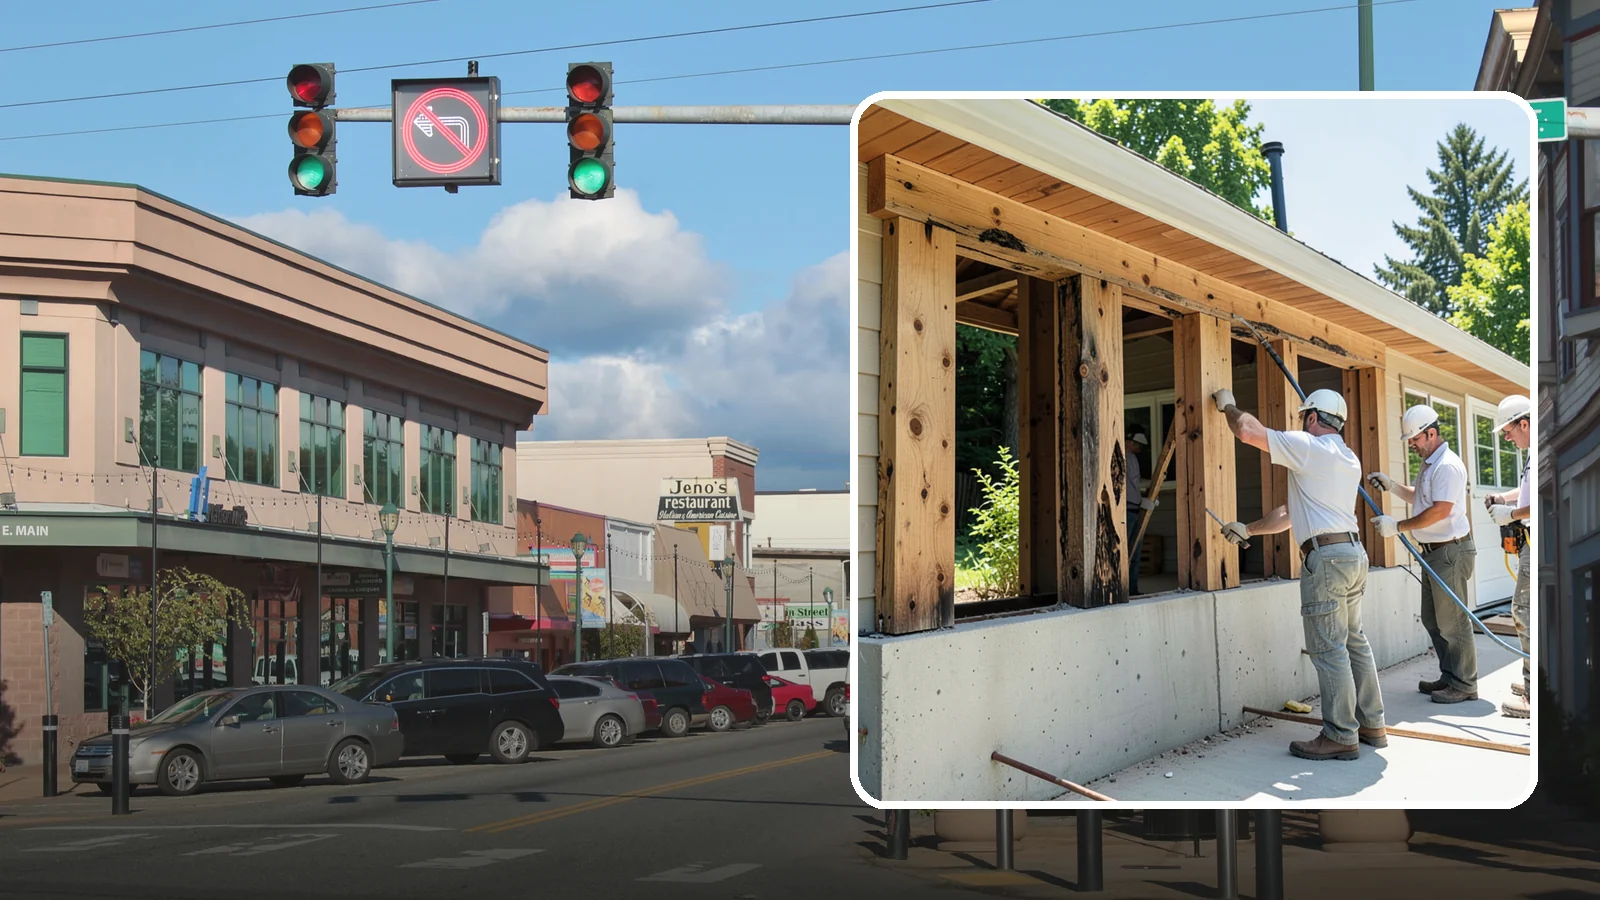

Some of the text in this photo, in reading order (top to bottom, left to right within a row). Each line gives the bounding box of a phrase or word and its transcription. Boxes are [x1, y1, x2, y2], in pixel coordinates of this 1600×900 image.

[670, 480, 728, 494] Jeno's
[665, 496, 731, 509] restaurant
[658, 510, 682, 520] Italian
[686, 510, 714, 519] American
[714, 510, 737, 519] Cuisine
[2, 525, 49, 536] E. MAIN
[797, 608, 829, 616] Street
[791, 619, 824, 627] lass
